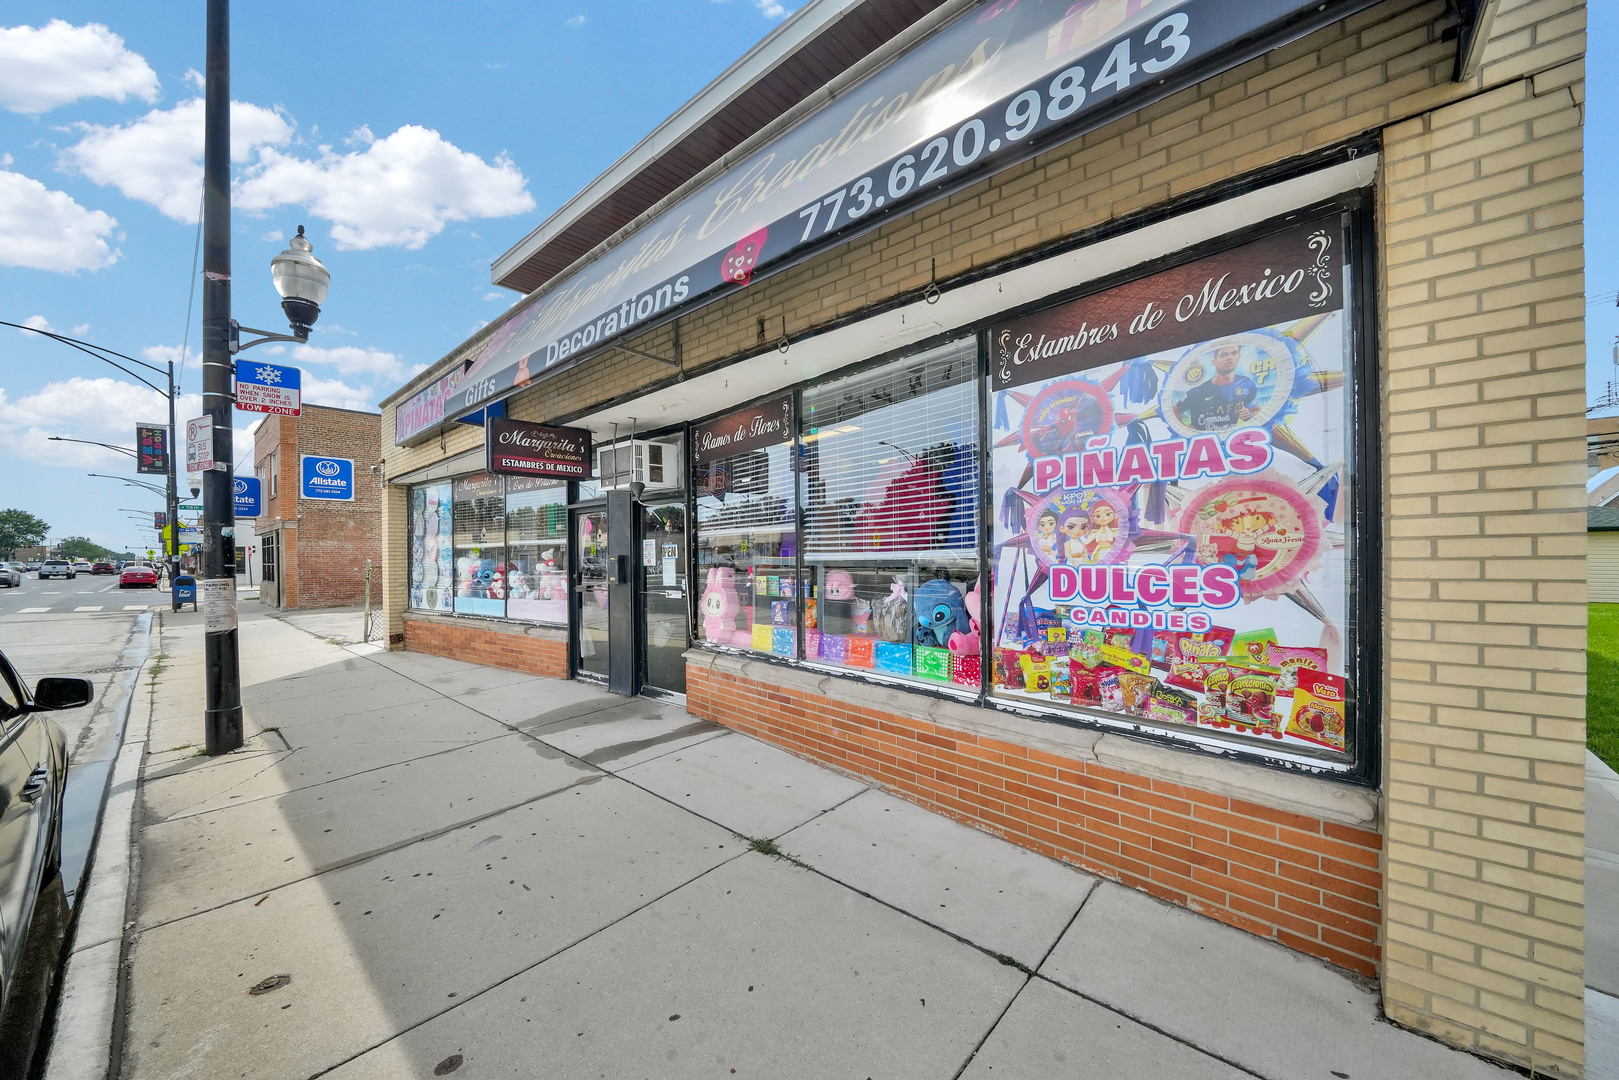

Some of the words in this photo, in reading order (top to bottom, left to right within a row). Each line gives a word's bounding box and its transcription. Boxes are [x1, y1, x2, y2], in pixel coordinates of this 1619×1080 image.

[800, 12, 1192, 243] 773.620.9843
[697, 40, 1005, 241] Creations
[1013, 321, 1119, 366] Estambres
[1129, 303, 1165, 334] de
[1175, 268, 1305, 323] Mexico
[465, 378, 496, 407] Gifts
[546, 275, 690, 367] Decorations
[1250, 358, 1276, 374] CR
[1255, 371, 1269, 384] 7
[253, 385, 281, 393] PARKING
[240, 402, 262, 411] TOW
[268, 406, 295, 415] ZONE
[701, 431, 731, 452] Ramos
[733, 427, 746, 443] de
[749, 415, 781, 440] Flores
[141, 428, 153, 466] WEST
[153, 429, 163, 467] ELSDON
[197, 442, 207, 452] BUS
[197, 451, 209, 461] STOP
[544, 449, 582, 462] Creaciones
[1035, 430, 1270, 490] PIÑATAS
[502, 458, 544, 470] ESTAMBRES
[545, 463, 555, 471] DE
[556, 465, 583, 474] MEXICO
[309, 476, 347, 487] Allstate
[1052, 566, 1238, 607] DULCES
[1072, 609, 1209, 631] CANDIES
[1315, 683, 1337, 698] Vero
[1310, 701, 1336, 714] Mango
